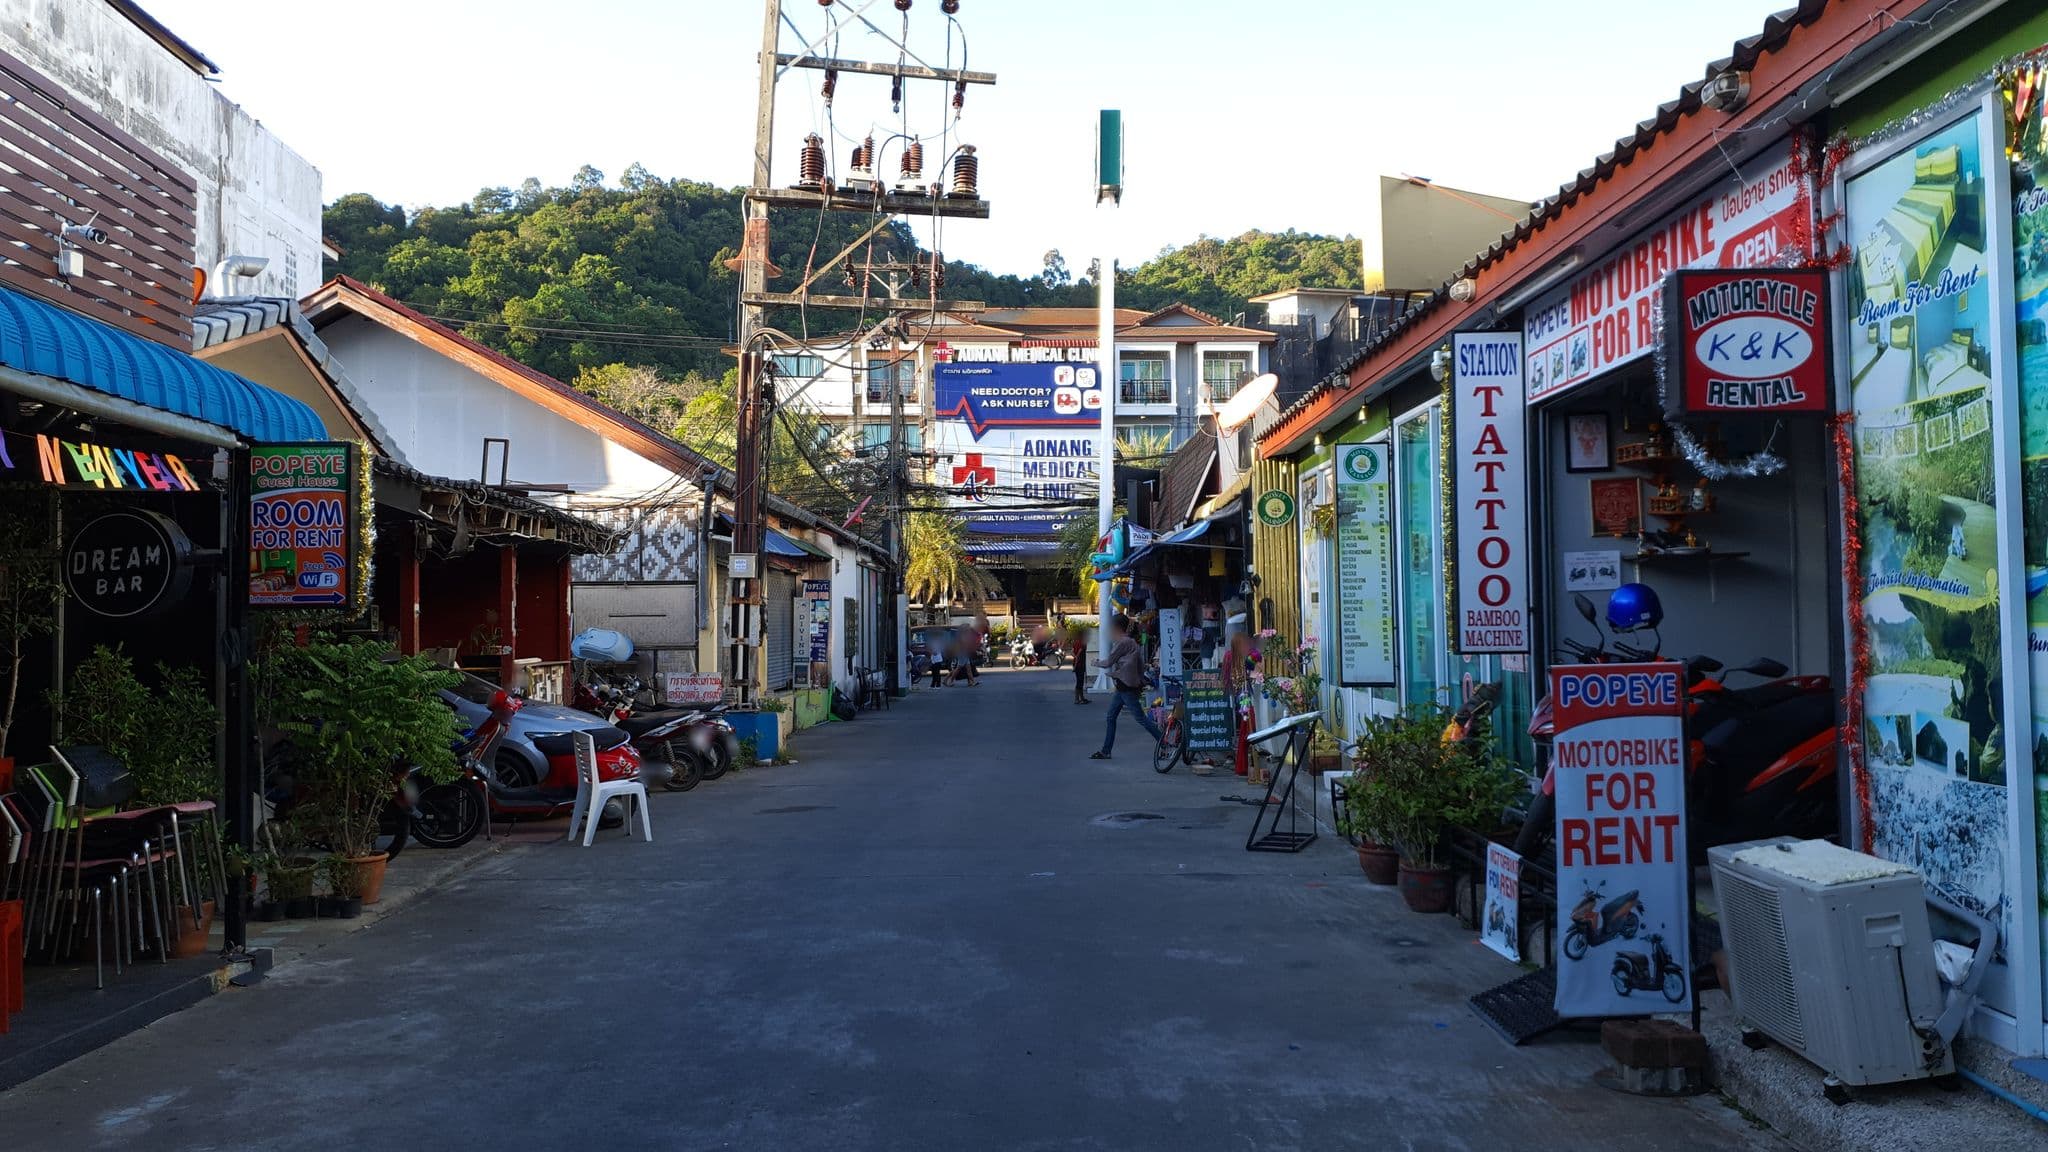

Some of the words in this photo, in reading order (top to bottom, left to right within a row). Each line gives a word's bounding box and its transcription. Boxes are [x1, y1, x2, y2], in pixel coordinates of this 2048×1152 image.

[1733, 226, 1777, 269] OPEN
[1528, 297, 1568, 345] POPEYE
[1570, 197, 1716, 327] MOTORBIKE
[1687, 278, 1817, 331] MOTORCYCLE
[1858, 297, 1900, 326] Room
[1903, 277, 1933, 316] For
[1934, 263, 1979, 301] Rent
[1593, 305, 1630, 369] FOR
[1708, 333, 1736, 362] K
[1740, 331, 1763, 360] &
[1771, 331, 1800, 360] K
[1460, 343, 1517, 377] STATION
[971, 387, 1000, 396] NEED
[1001, 387, 1051, 396] DOCTOR?
[981, 399, 1004, 408] ASK
[1006, 399, 1049, 408] NURSE?
[1706, 376, 1805, 407] RENTAL
[1024, 439, 1092, 456] AONANG
[1350, 449, 1373, 458] MONEY
[37, 433, 122, 489] NEW
[114, 448, 200, 492] YEAR
[251, 455, 345, 475] POPEYE
[1023, 461, 1093, 478] MEDICAL
[1348, 467, 1376, 479] MASSAGE
[257, 476, 295, 488] Guest
[298, 475, 338, 487] House
[1024, 482, 1076, 500] CLINIC
[1264, 491, 1288, 500] MONEY
[1472, 385, 1511, 607] TATTOO
[251, 499, 344, 528] ROOM
[1264, 513, 1290, 525] MASSAGE
[252, 529, 291, 549] FOR
[295, 528, 343, 549] RENT
[73, 544, 160, 575] DREAM
[303, 562, 324, 571] Free
[96, 575, 142, 595] BAR
[1869, 570, 1902, 592] Tourist
[1904, 569, 1969, 596] Information
[249, 594, 291, 603] Information
[1467, 609, 1520, 627] BAMBOO
[1168, 627, 1176, 673] DIVING
[1465, 629, 1523, 648] MACHINE
[1559, 672, 1677, 707] POPEYE
[1558, 738, 1679, 768] MOTORBIKE
[1586, 772, 1656, 811] FOR
[1562, 815, 1680, 867] RENT
[1501, 873, 1519, 900] RENT
